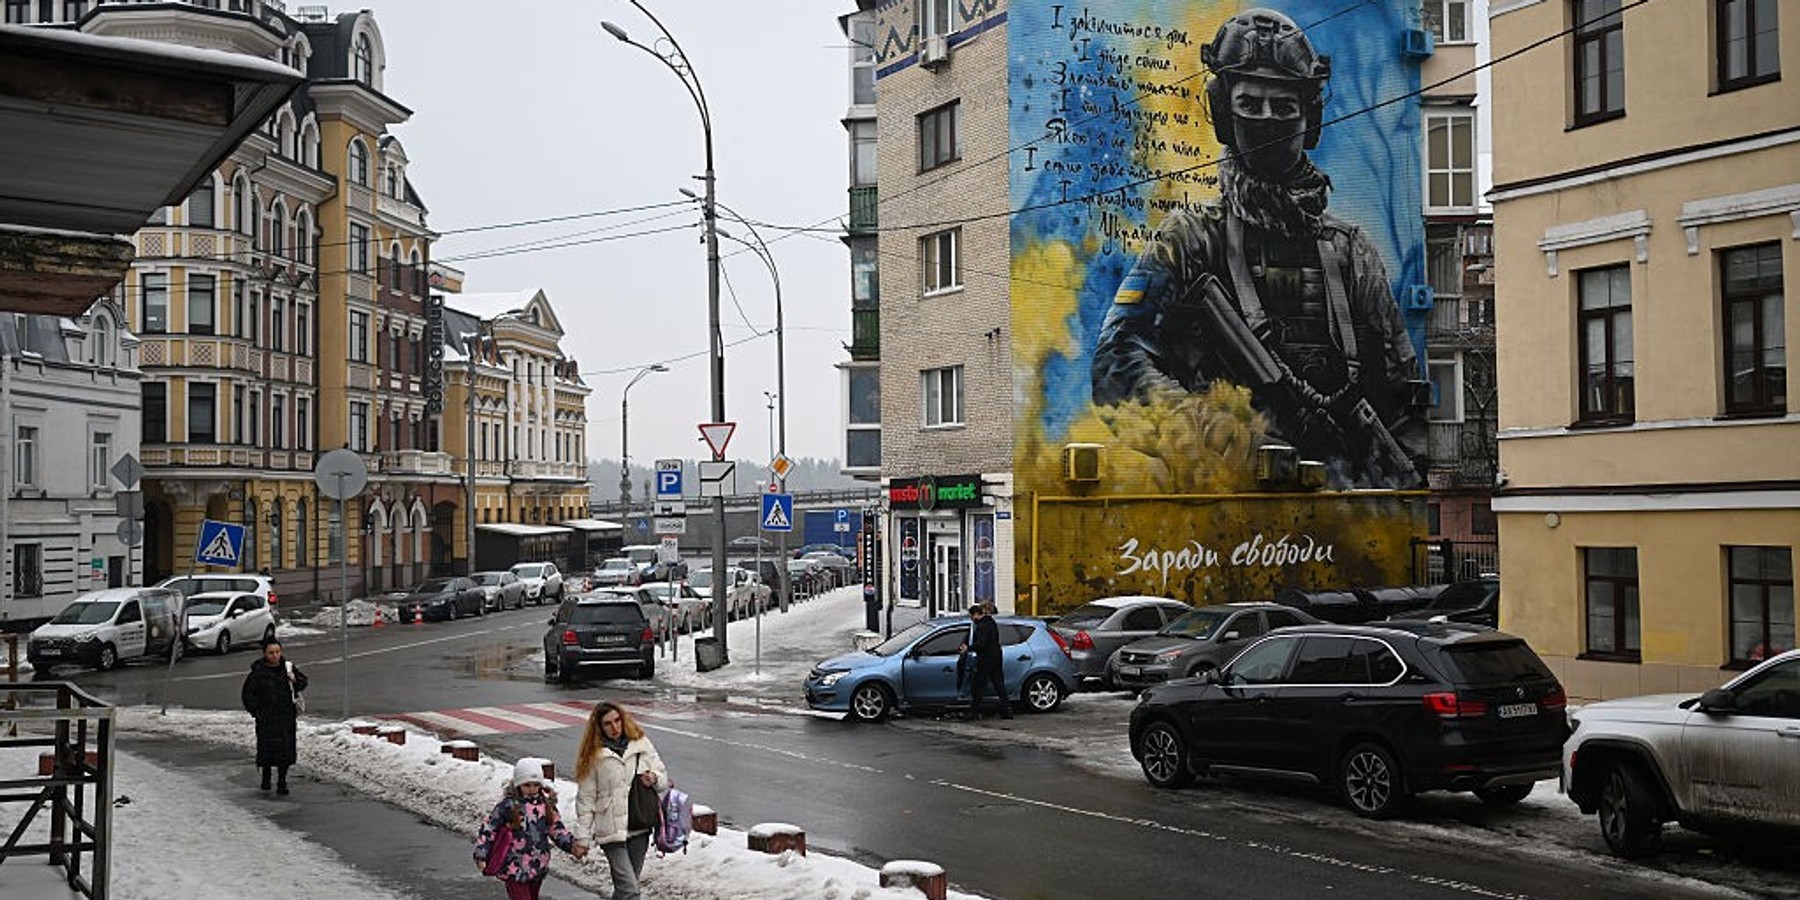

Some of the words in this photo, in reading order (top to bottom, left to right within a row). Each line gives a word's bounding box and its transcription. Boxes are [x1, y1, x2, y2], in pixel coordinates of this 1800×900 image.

[1051, 5, 1064, 29] І
[1079, 38, 1092, 62] І
[1059, 89, 1071, 111] І
[1025, 148, 1038, 171] І
[1059, 180, 1071, 203] І
[1116, 537, 1221, 589] Заради
[1231, 532, 1335, 567] свободи
